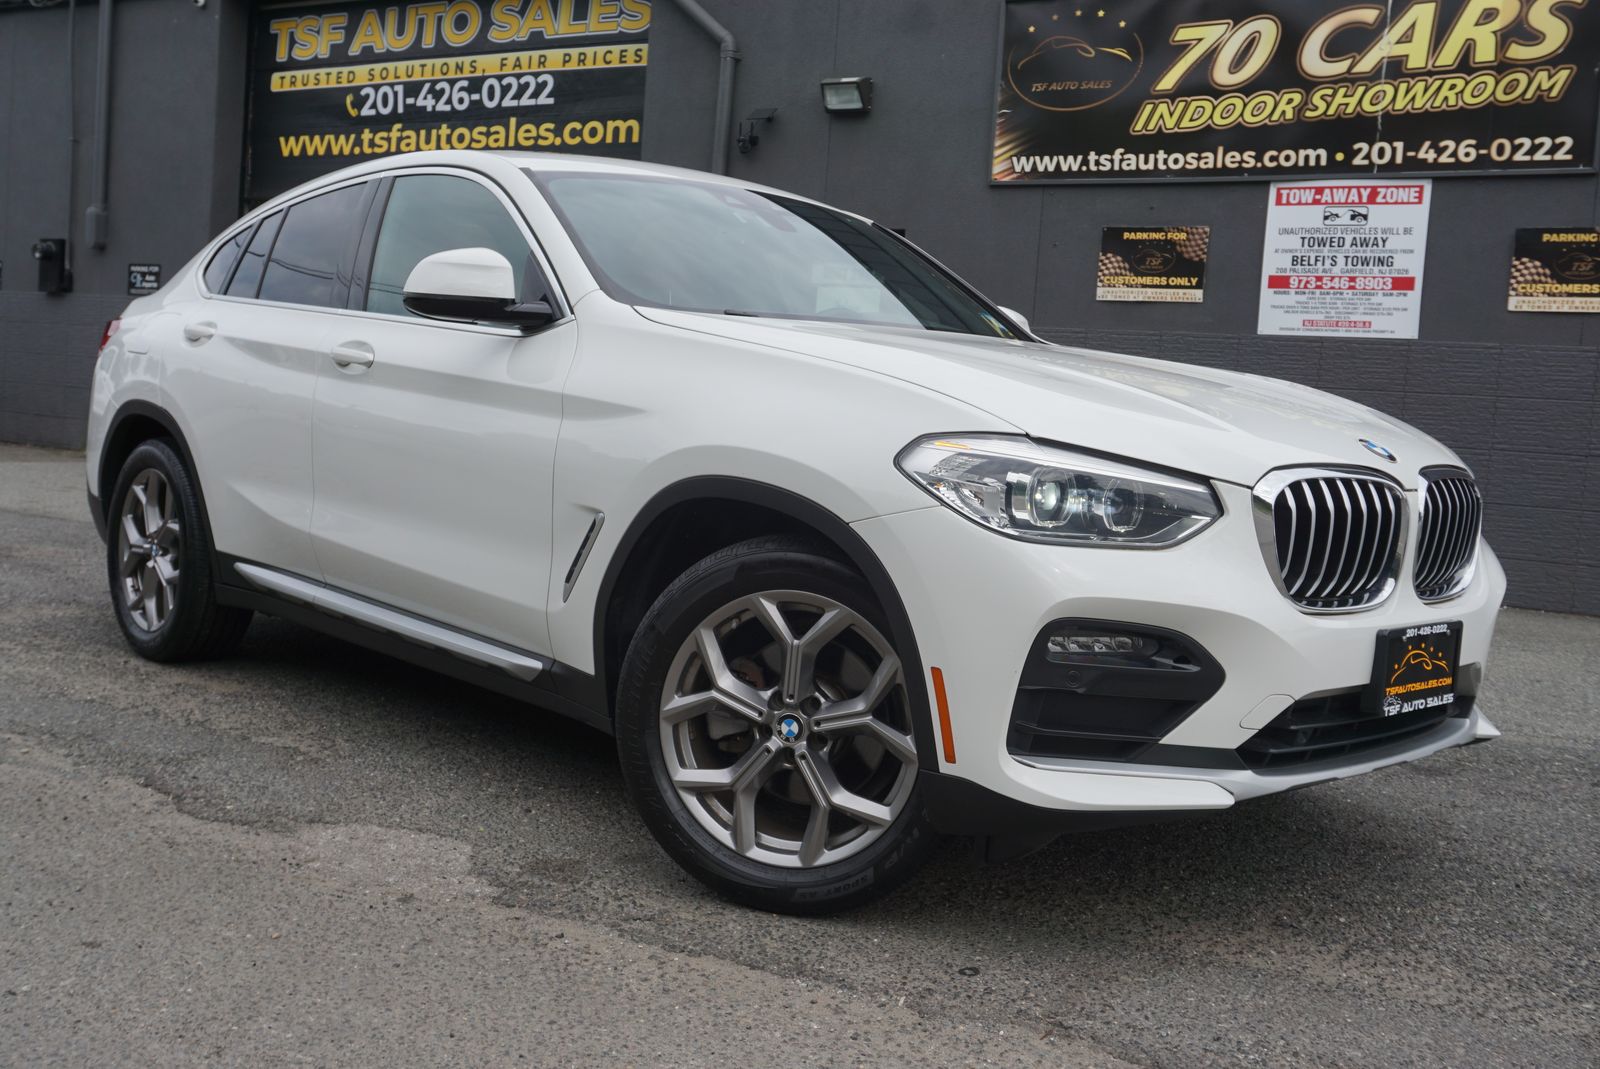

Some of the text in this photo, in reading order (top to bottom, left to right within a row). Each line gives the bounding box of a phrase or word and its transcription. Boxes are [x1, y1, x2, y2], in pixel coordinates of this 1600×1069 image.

[270, 0, 652, 62] TSF AUTO SALES
[1151, 0, 1590, 93] 70 CARS
[279, 48, 643, 88] TRUSTED SOLUTIONS, FAIR PRICES
[1031, 80, 1113, 92] TSF AUTO SALES
[360, 73, 555, 116] 201-426-0222
[1130, 65, 1577, 135] INDOOR SHOWROOM
[279, 117, 640, 157] www.tsfautosales.com
[1011, 136, 1574, 174] www.tsfautosales.com 201-426-0222
[1279, 187, 1420, 205] TOW-AWAY ZONE
[1123, 232, 1187, 240] PARKING FOR
[1278, 226, 1414, 236] UNAUTHORIZED VEHICLES WILL BE
[1542, 233, 1598, 242] PARKING
[1300, 236, 1389, 248] TOWED AWAY
[1291, 255, 1394, 267] BELFI'S TOWING
[1103, 276, 1198, 286] CUSTOMERS ONLY
[1289, 277, 1392, 290] 973-546-8903
[1518, 283, 1600, 293] CUSTOMERS
[1406, 624, 1448, 637] 201-426-0222
[1385, 676, 1453, 695] TSFAUTOSALES.COM
[1383, 692, 1454, 717] TSF AUTO SALES
